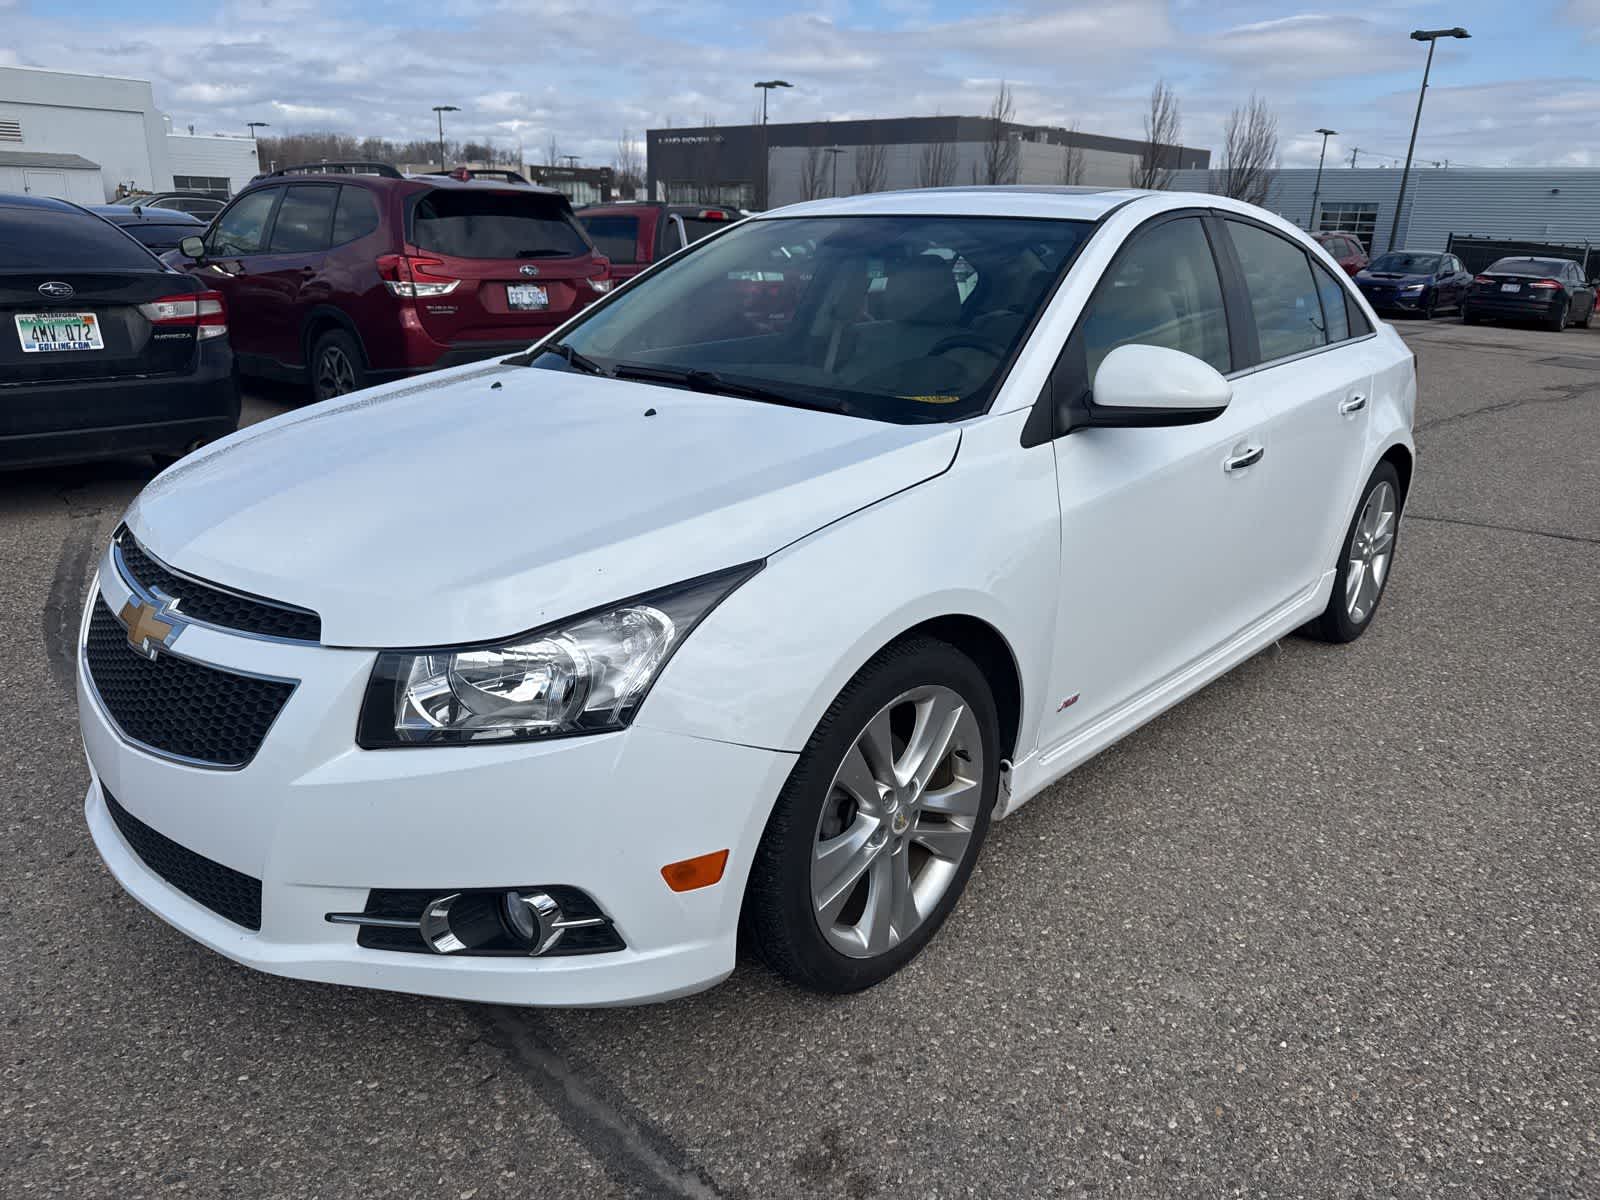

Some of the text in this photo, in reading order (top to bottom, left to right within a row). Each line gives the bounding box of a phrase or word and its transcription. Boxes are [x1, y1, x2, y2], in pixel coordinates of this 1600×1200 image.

[32, 324, 93, 342] 4MV Q72
[38, 342, 91, 351] GOLLING.COM
